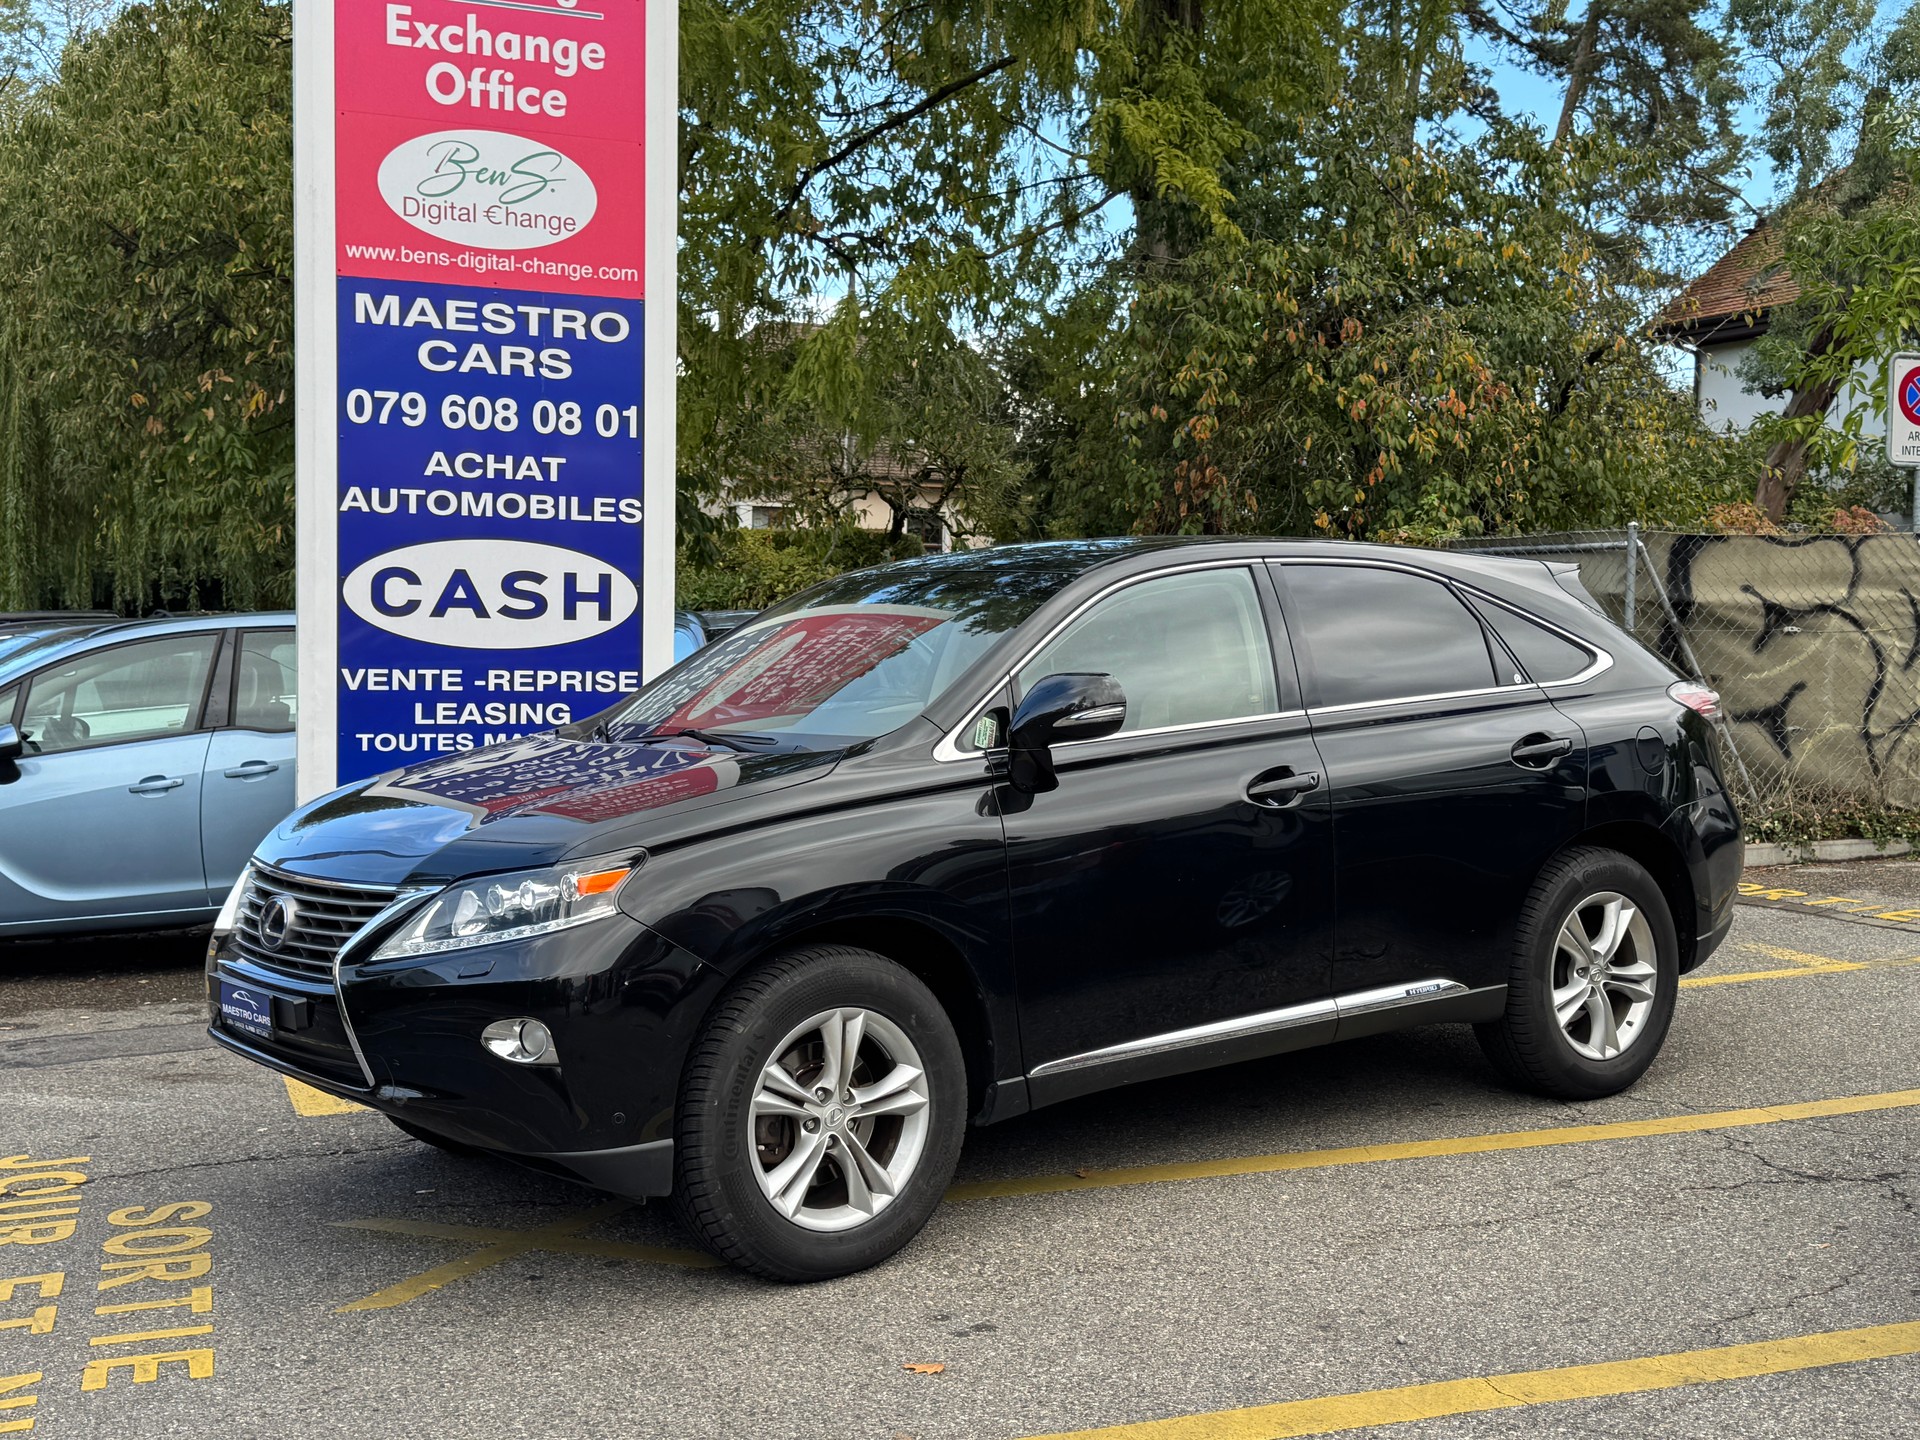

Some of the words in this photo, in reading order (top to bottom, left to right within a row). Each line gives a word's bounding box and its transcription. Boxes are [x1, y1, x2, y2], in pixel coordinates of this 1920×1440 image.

[386, 3, 606, 77] Exchange
[425, 61, 568, 118] Office
[402, 196, 477, 226] Digital
[345, 243, 638, 282] www.bens-digital-change.com
[354, 292, 630, 343] MAESTRO
[417, 339, 573, 379] CARS
[346, 388, 427, 427] 079
[441, 394, 519, 432] 608
[532, 400, 582, 436] 08
[595, 404, 638, 438] 01
[423, 451, 567, 482] ACHAT
[339, 486, 643, 524] AUTOMOBILES
[370, 566, 612, 622] CASH
[341, 668, 463, 692] VENTE
[474, 669, 639, 693] -REPRISE
[414, 702, 572, 725] LEASING
[355, 733, 474, 752] TOUTES
[222, 1003, 253, 1021] MAESTRO
[253, 1013, 271, 1027] CARS
[80, 1200, 214, 1391] SORTIE
